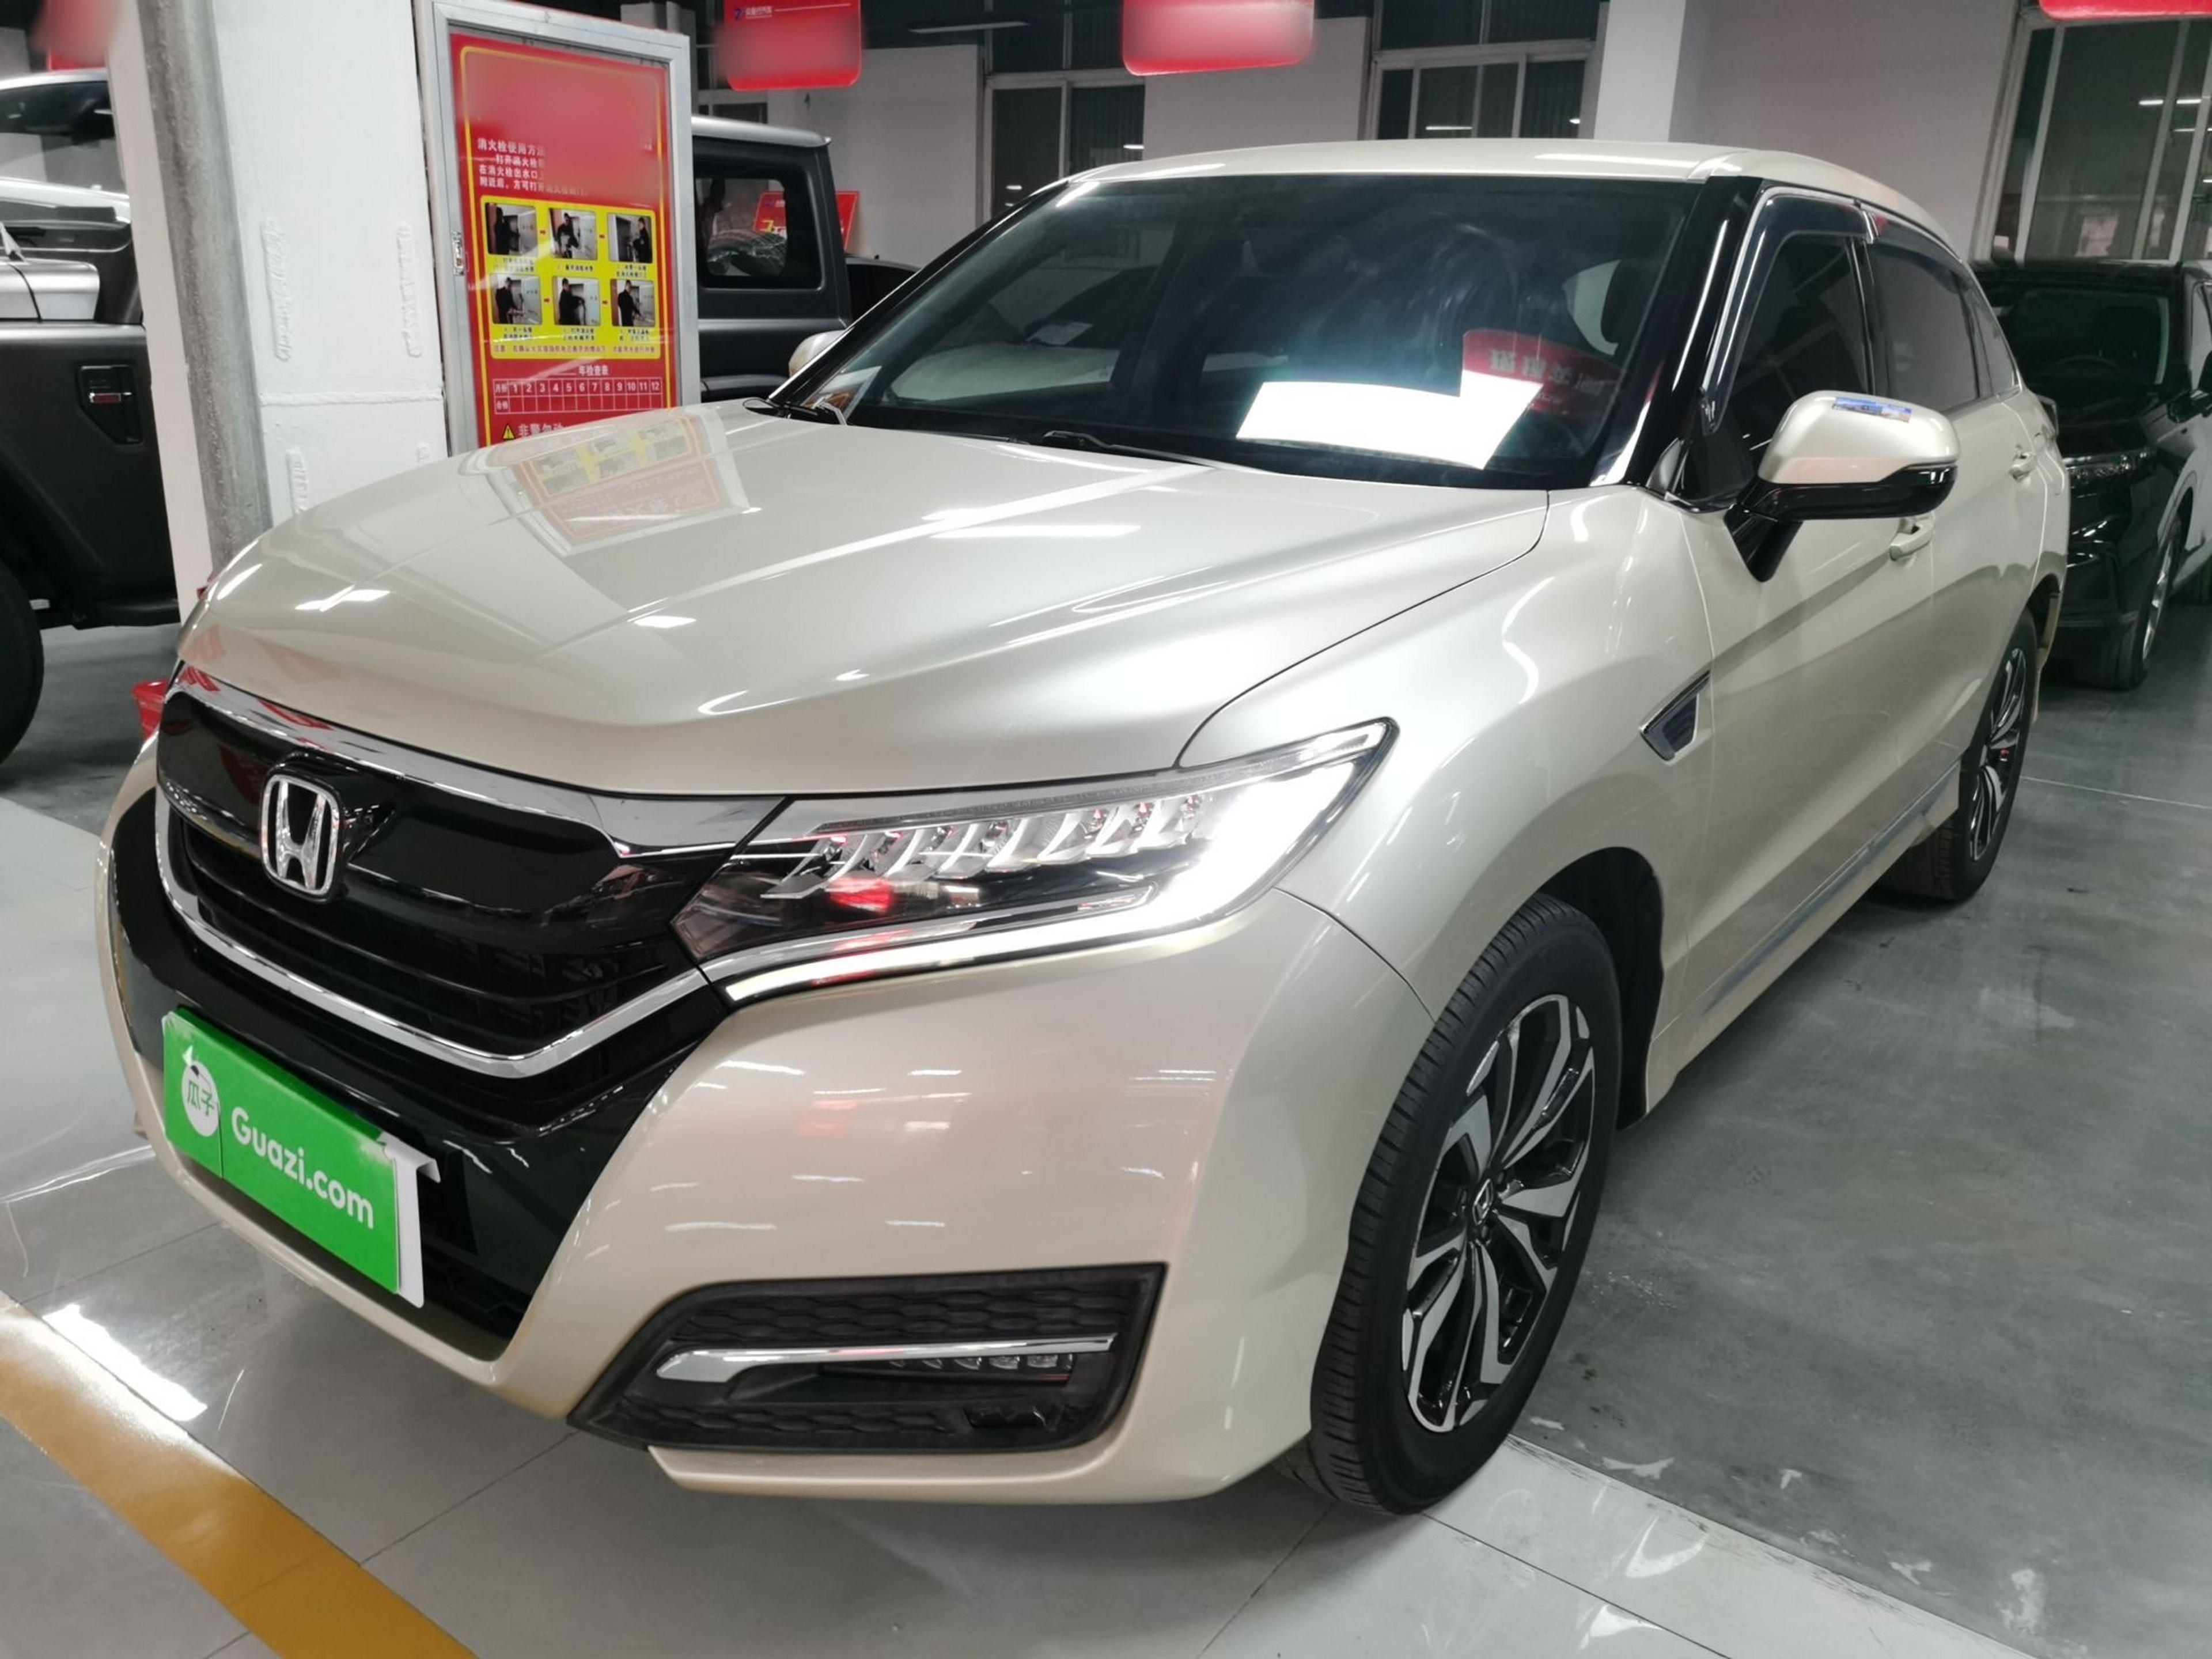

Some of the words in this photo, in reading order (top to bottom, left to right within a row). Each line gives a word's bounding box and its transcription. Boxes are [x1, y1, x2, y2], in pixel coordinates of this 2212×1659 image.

[526, 384, 532, 393] 2
[539, 384, 546, 393] 3
[552, 384, 559, 392] 4
[566, 383, 572, 392] 5
[579, 382, 585, 392] 6
[592, 382, 598, 391] 7
[604, 382, 611, 391] 8
[617, 382, 623, 391] 9
[627, 382, 636, 391] 10
[639, 382, 648, 391] 11
[651, 381, 660, 391] 12
[187, 1080, 215, 1116] 瓜子
[231, 1107, 374, 1230] Guazi.com
